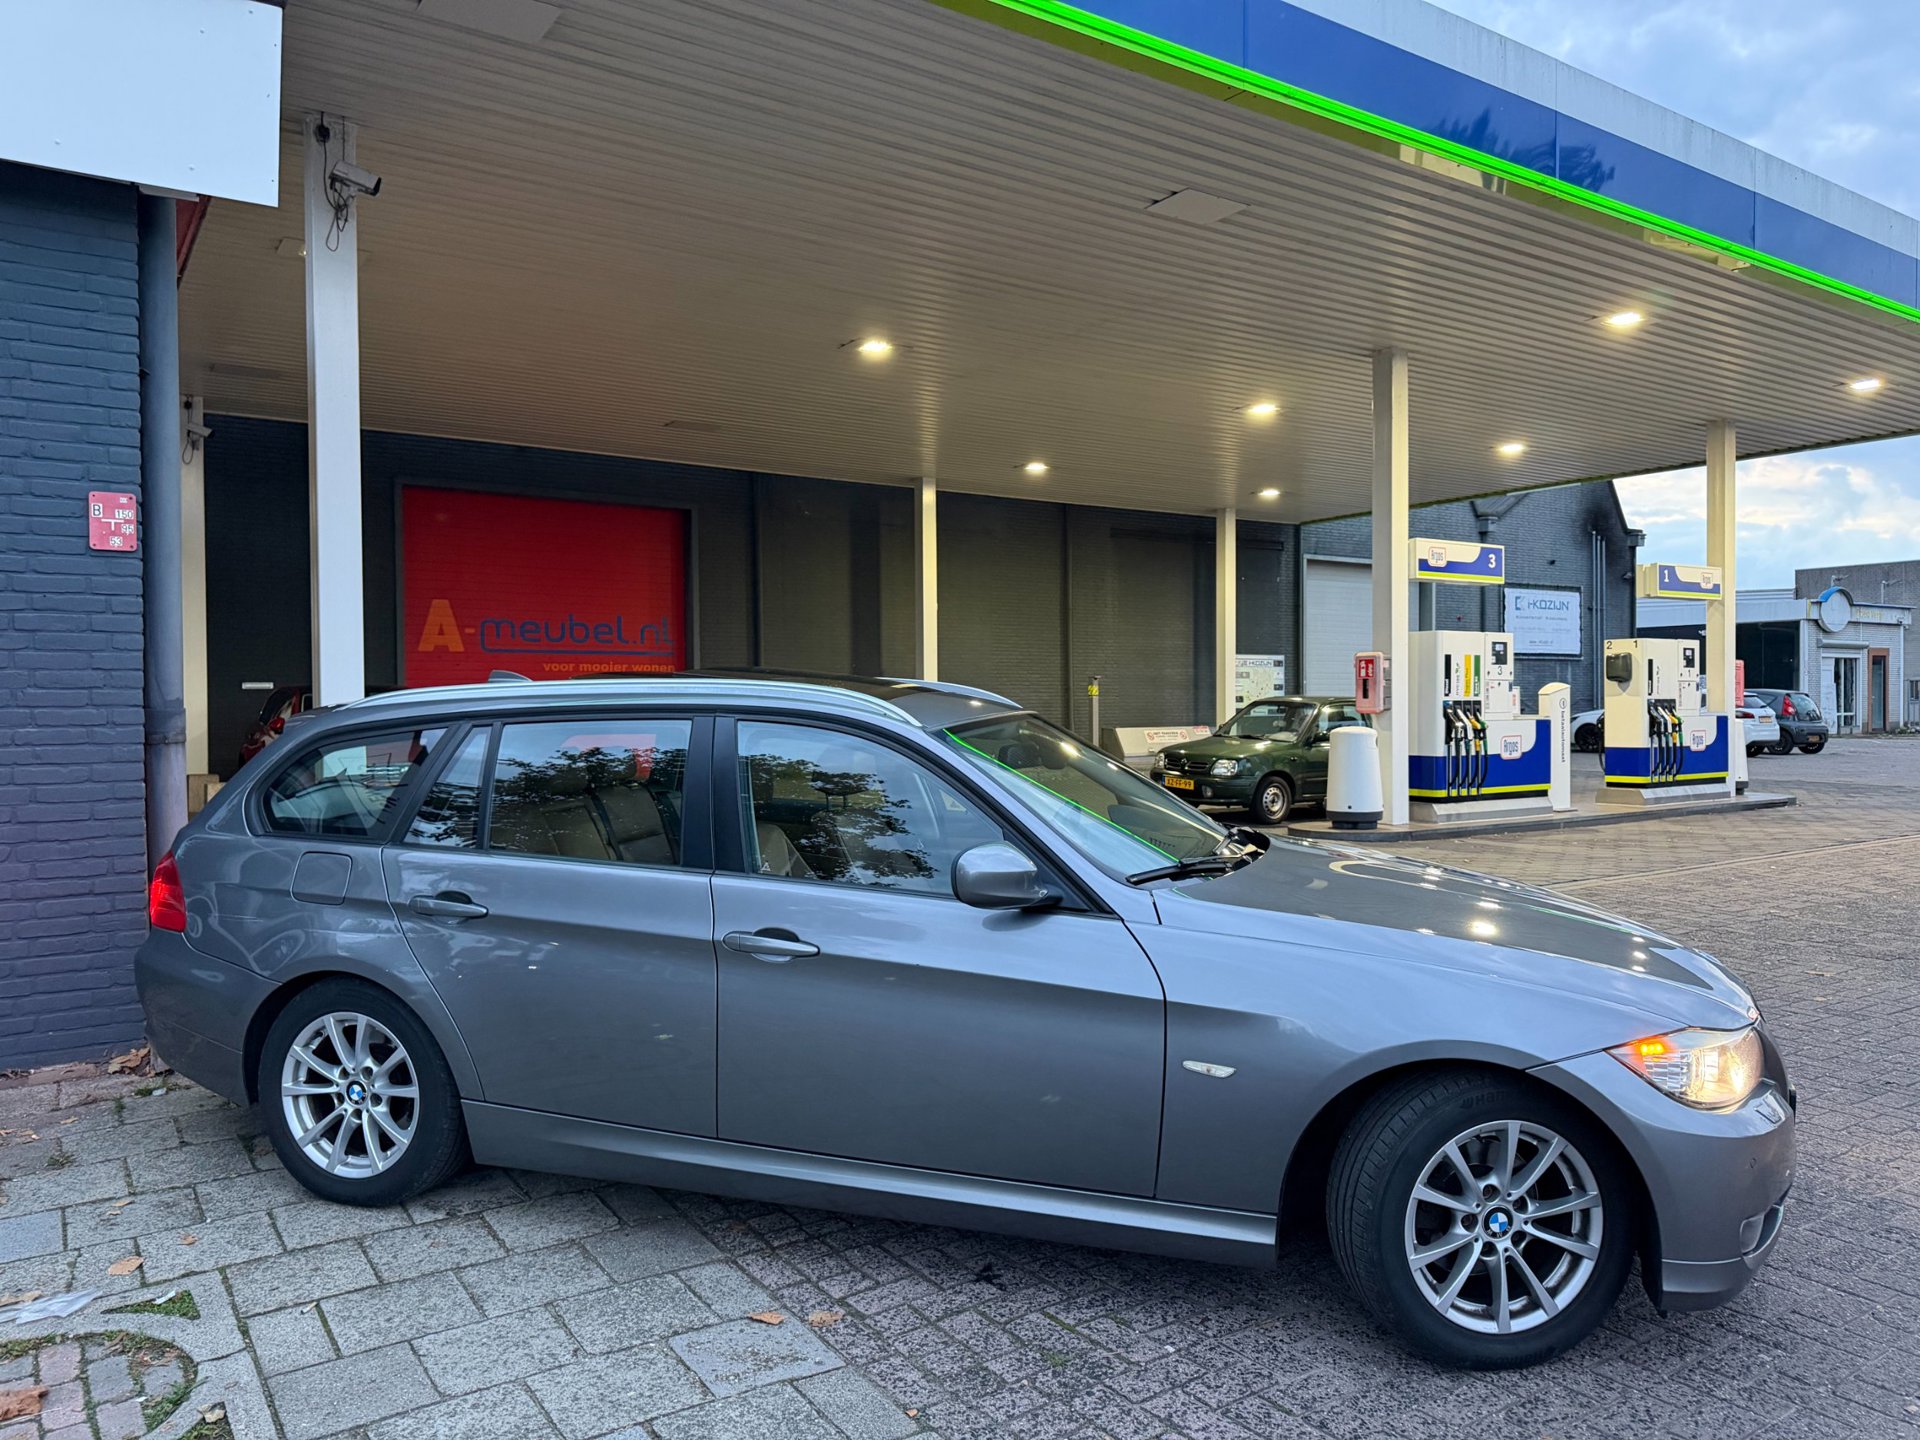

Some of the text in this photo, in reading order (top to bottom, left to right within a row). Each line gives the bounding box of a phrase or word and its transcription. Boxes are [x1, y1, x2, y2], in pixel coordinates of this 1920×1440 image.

[92, 504, 102, 516] B
[116, 510, 133, 519] 150
[1488, 554, 1496, 568] 3
[1664, 569, 1669, 582] 1
[418, 599, 675, 655] A-meubel.nl
[1606, 641, 1612, 649] 2
[543, 661, 675, 672] voor mooier wonen
[1498, 666, 1503, 675] 3
[1504, 739, 1519, 755] Argos
